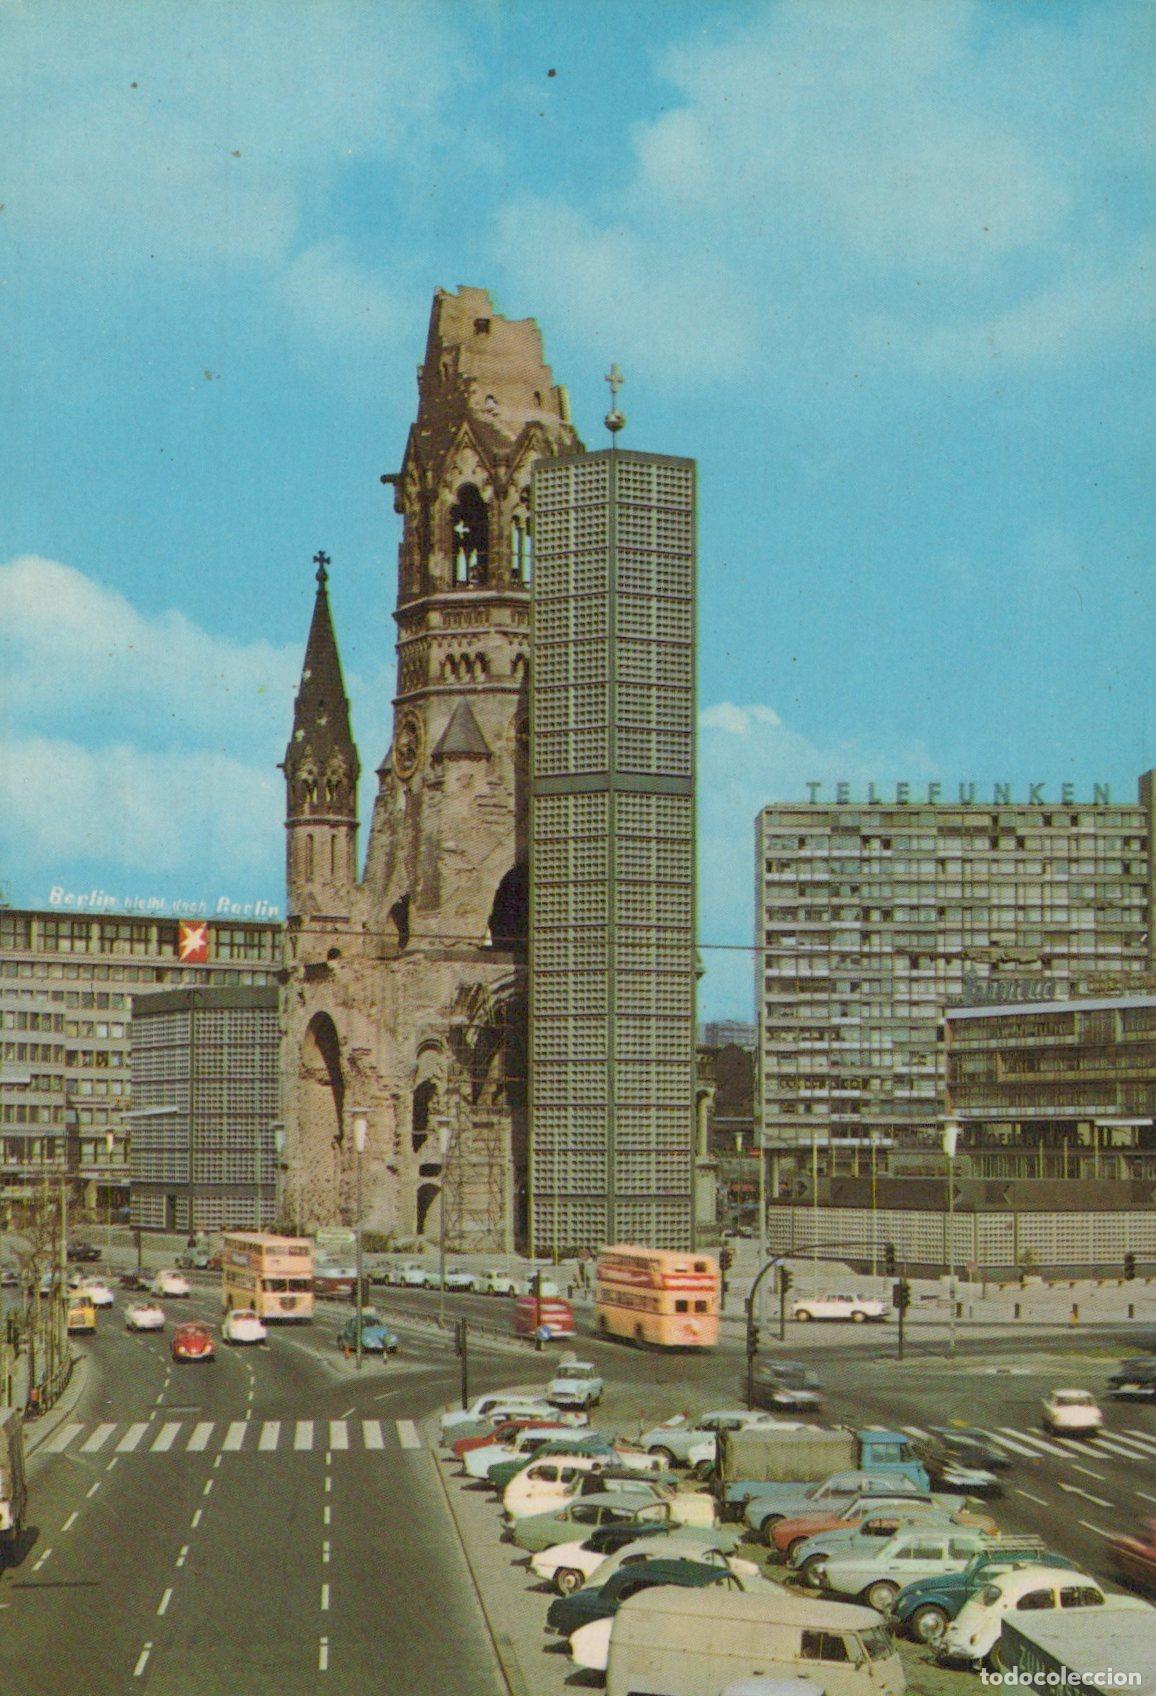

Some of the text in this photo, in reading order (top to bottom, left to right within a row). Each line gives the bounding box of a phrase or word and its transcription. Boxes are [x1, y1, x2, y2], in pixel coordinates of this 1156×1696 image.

[806, 781, 1111, 805] TELEFUNKEN
[49, 886, 117, 907] Berlin
[216, 896, 279, 916] Berlin
